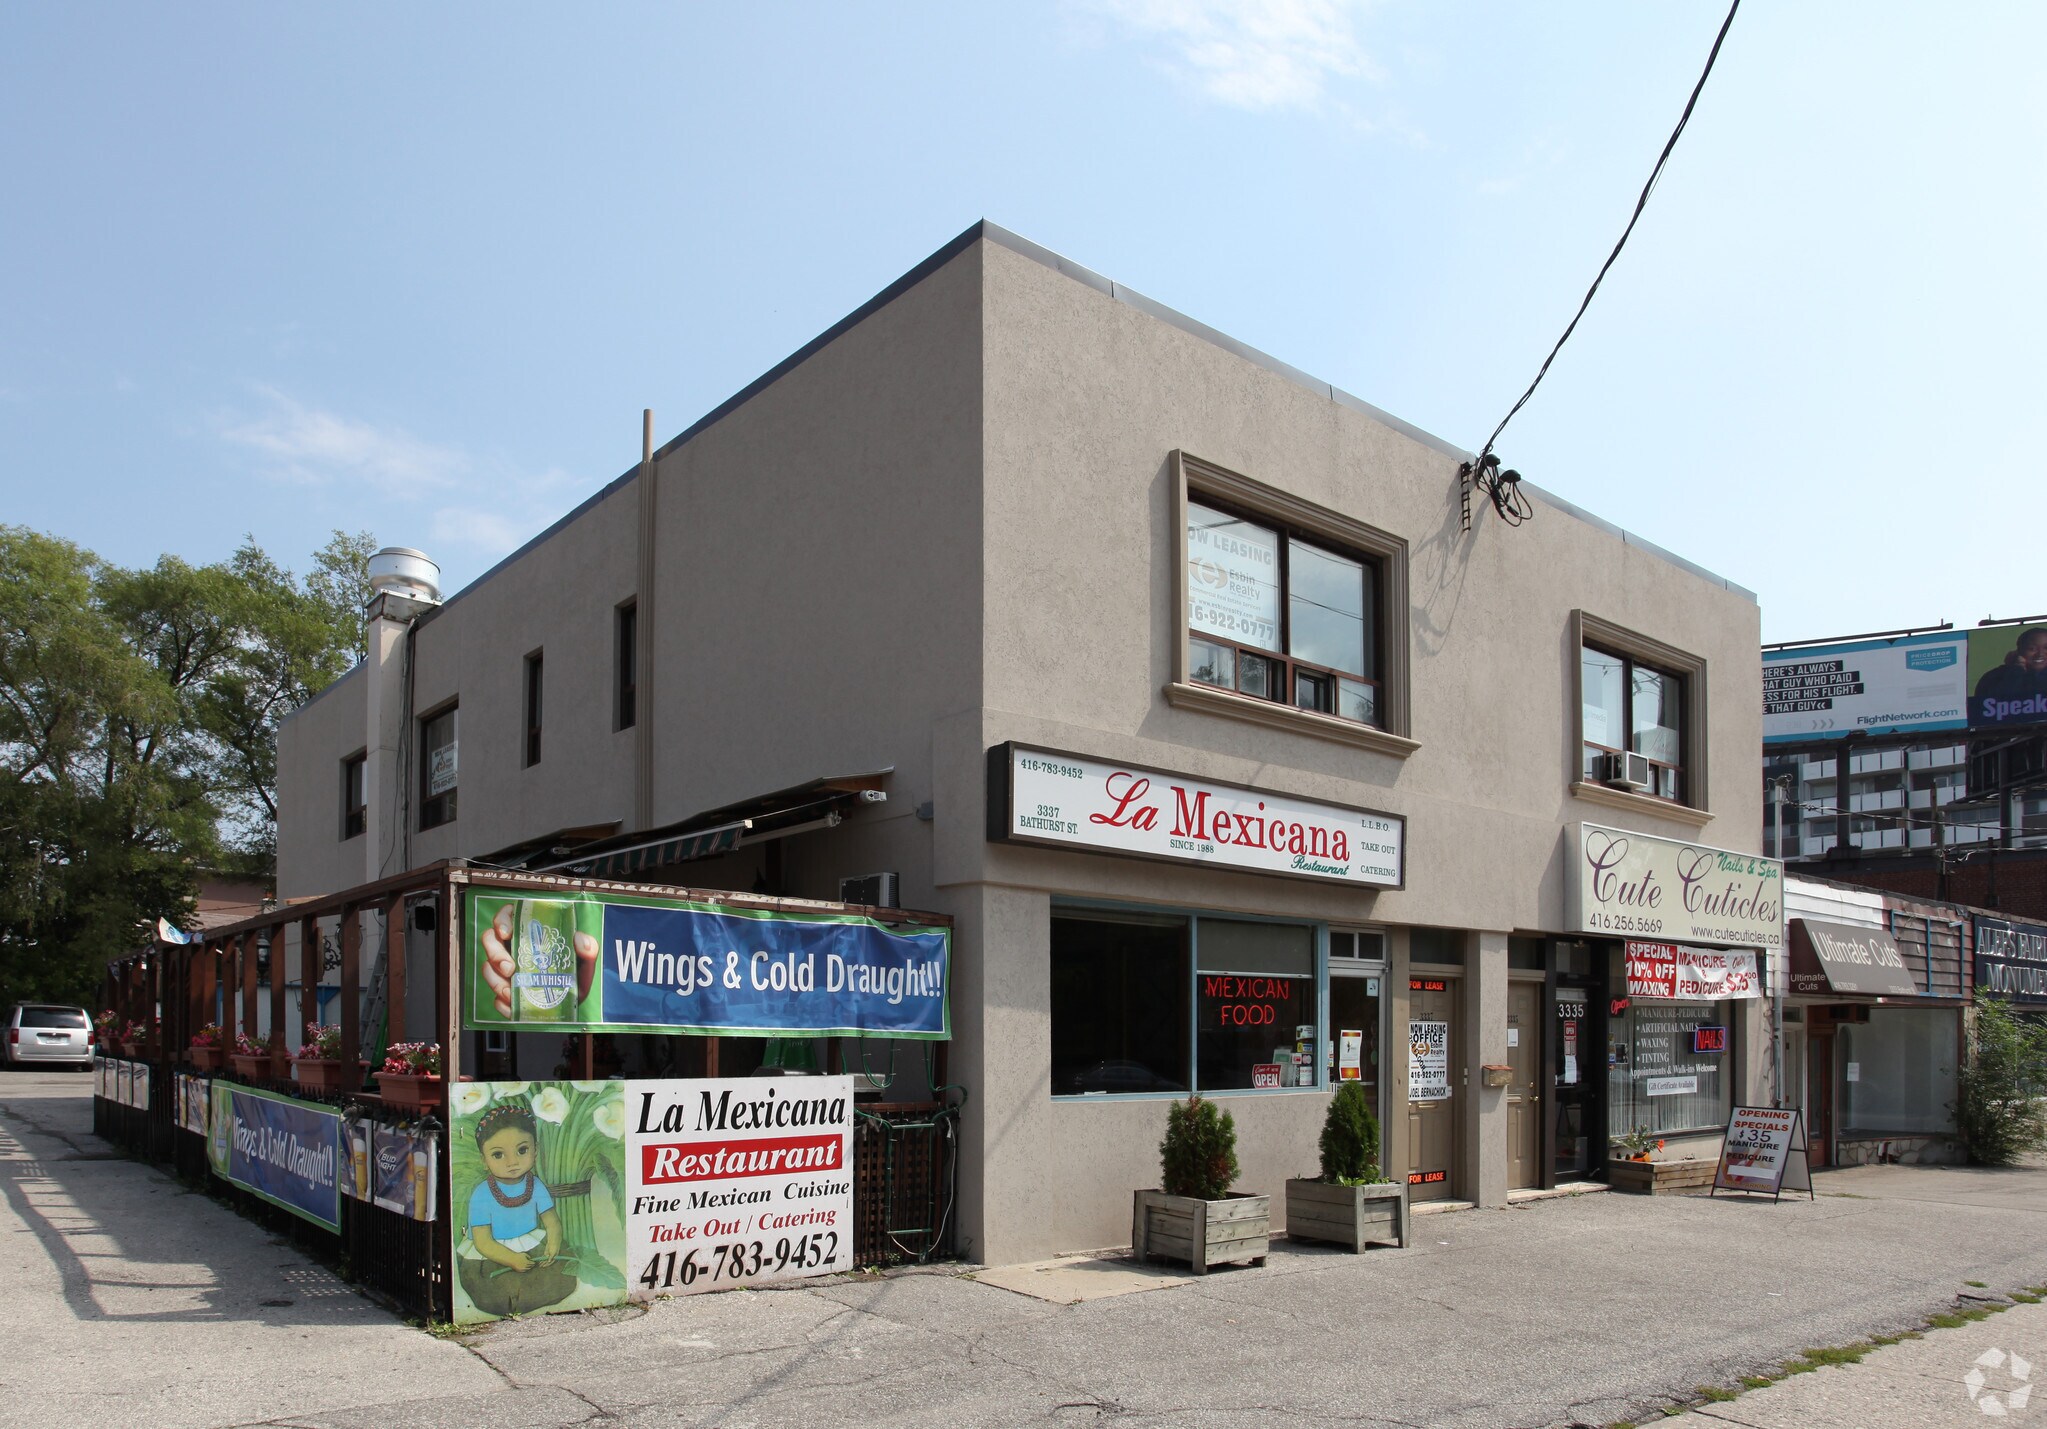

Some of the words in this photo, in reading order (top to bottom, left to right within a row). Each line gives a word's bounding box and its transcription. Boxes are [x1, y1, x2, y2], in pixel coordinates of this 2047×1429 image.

[1188, 528, 1209, 545] OW
[1213, 535, 1272, 566] LEASING
[1229, 568, 1256, 586] Esbin
[1229, 581, 1261, 600] Realty
[1188, 603, 1274, 641] 16-922-0777
[1762, 666, 1794, 678] HERE'S
[1796, 662, 1837, 675] ALWAYS
[1911, 658, 1951, 667] PROTECTION
[1762, 679, 1780, 690] HAT
[1783, 677, 1802, 688] GUY
[1804, 675, 1827, 686] WHO
[1829, 672, 1852, 684] PAID
[1762, 691, 1779, 703] ESS
[1782, 690, 1800, 700] FOR
[1803, 688, 1819, 698] HIS
[1822, 684, 1857, 697] FLIGHT.
[1762, 705, 1768, 714] E
[1771, 702, 1795, 713] THAT
[1857, 709, 1958, 725] FlightNetwork.com
[1020, 758, 1083, 779] 416-783-9452
[1037, 804, 1060, 818] 3337
[1089, 771, 1159, 831] La
[1169, 785, 1350, 862] Mexicana
[1020, 815, 1065, 832] BATHURST
[1067, 822, 1079, 835] ST.
[1361, 819, 1391, 832] L.L.B.O.
[1169, 839, 1195, 851] SINCE
[1196, 843, 1214, 854] 1988
[1361, 841, 1380, 853] TAKE
[1381, 845, 1396, 855] OUT
[1290, 854, 1350, 876] Restaurant
[1360, 864, 1396, 878] CATERING
[1716, 851, 1744, 873] Nails
[1746, 858, 1756, 875] &
[1757, 859, 1778, 882] Spa
[1585, 830, 1663, 910] Cute
[1676, 847, 1779, 923] Cuticles
[1589, 912, 1663, 933] 416.256.5669
[1690, 925, 1780, 944] www.cutecuticles.ca
[1629, 942, 1673, 961] SPECIAL
[1811, 931, 1872, 966] Ultimate
[1869, 938, 1903, 969] Cuts
[1678, 951, 1727, 969] MANICURE
[615, 939, 714, 997] Wings
[722, 951, 742, 989] &
[750, 950, 815, 992] Cold
[826, 953, 941, 1005] Draught!!
[1625, 961, 1652, 979] 10%
[1655, 963, 1676, 979] OFF
[1790, 973, 1826, 983] Ultimate
[1205, 977, 1289, 1000] MEXICAN
[1408, 980, 1422, 990] FOR
[1425, 981, 1444, 991] LEASE
[1629, 980, 1670, 996] WAXING
[1679, 979, 1727, 995] PEDICURE
[1798, 982, 1819, 991] Cuts
[1558, 1003, 1584, 1018] 3335
[1610, 998, 1632, 1015] Open
[1640, 1007, 1711, 1018] MANICURE-PEDICURE
[1221, 1004, 1275, 1026] FOOD
[1410, 1023, 1423, 1034] NOW
[1424, 1023, 1446, 1035] LEASING
[1640, 1022, 1680, 1034] ARTIFICIAL
[1680, 1022, 1699, 1033] NAILS
[1413, 1033, 1443, 1043] OFFICE
[1640, 1037, 1669, 1048] WAXING
[1697, 1030, 1724, 1050] NAILS
[1641, 1052, 1670, 1064] TINTING
[1630, 1066, 1667, 1079] Appointments
[1666, 1065, 1672, 1075] &
[1672, 1064, 1695, 1074] Walk-ins
[1695, 1063, 1717, 1072] Welcome
[1254, 1073, 1279, 1087] OPEN
[635, 1092, 684, 1134] La
[694, 1087, 846, 1131] Mexicana
[1738, 1109, 1790, 1120] OPENING
[1733, 1120, 1789, 1132] SPECIALS
[1727, 1140, 1780, 1151] MANICURE
[258, 1127, 267, 1161] &
[267, 1126, 289, 1169] Cold
[287, 1133, 333, 1191] Draught!!
[381, 1153, 397, 1163] BUD
[649, 1140, 838, 1179] Restaurant
[1726, 1152, 1775, 1163] PEDICURE
[1408, 1174, 1422, 1184] FOR
[1425, 1171, 1444, 1182] LEASE
[632, 1196, 681, 1215] Fine
[687, 1187, 772, 1210] Mexican
[783, 1179, 850, 1200] Cuisine
[648, 1223, 697, 1243] Take
[703, 1218, 741, 1237] Out
[745, 1214, 753, 1234] /
[758, 1207, 837, 1231] Catering
[640, 1230, 838, 1290] 416-783-9452
